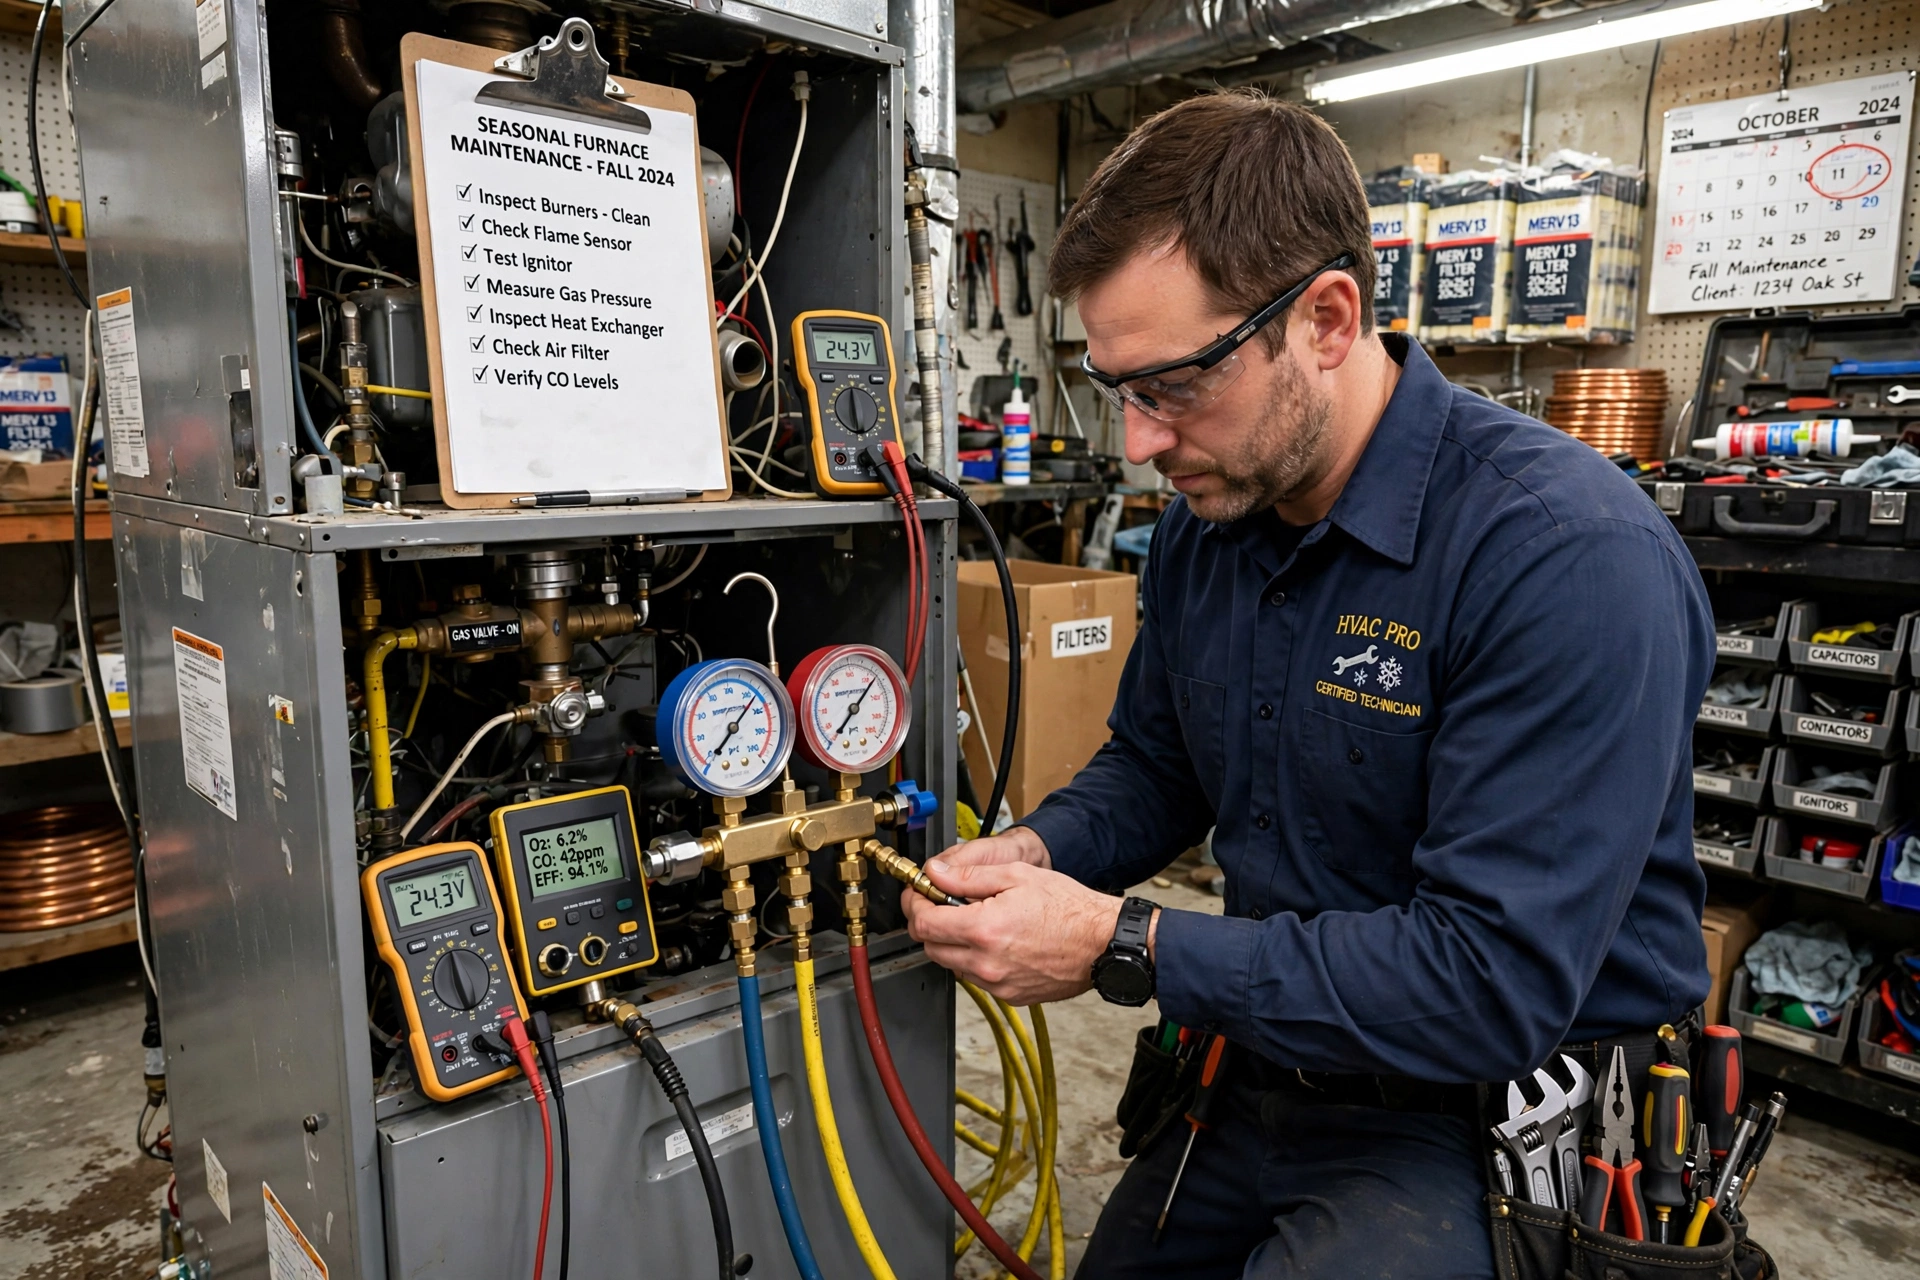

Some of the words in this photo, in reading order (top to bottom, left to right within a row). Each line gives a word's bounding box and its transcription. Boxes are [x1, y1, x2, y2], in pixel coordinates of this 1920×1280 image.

[1738, 107, 1820, 132] OCTOBER
[1858, 96, 1901, 115] 2024
[478, 116, 570, 147] SEASONAL
[574, 134, 650, 160] FURNACE
[1873, 130, 1882, 141] 6
[450, 135, 582, 171] MAINTENANCE
[597, 160, 634, 180] FALL
[638, 167, 675, 187] 2024
[1736, 179, 1744, 190] 9
[1832, 168, 1845, 180] 11
[1867, 163, 1882, 176] 12
[479, 188, 537, 211] Inspect
[541, 197, 598, 219] Burners
[612, 208, 651, 227] Clean
[1731, 208, 1744, 220] 15
[1763, 205, 1777, 217] 16
[1795, 202, 1809, 213] 17
[1370, 221, 1390, 236] ERV
[1438, 220, 1474, 236] MERV
[1475, 218, 1487, 232] 13
[1528, 215, 1566, 232] MERV
[1567, 213, 1580, 228] 13
[482, 219, 529, 239] Check
[534, 225, 580, 245] Flame
[583, 231, 632, 251] Sensor
[1696, 241, 1711, 253] 21
[1726, 238, 1742, 250] 22
[1757, 236, 1774, 248] 24
[1858, 227, 1876, 240] 29
[483, 248, 518, 267] Test
[523, 253, 573, 272] Ignitor
[1435, 248, 1468, 264] MERV
[1470, 246, 1483, 261] 13
[1525, 244, 1561, 261] MERV
[1563, 243, 1577, 258] 13
[1439, 262, 1476, 277] FILTER
[1529, 258, 1569, 274] FILTER
[1688, 262, 1719, 280] Fall
[1727, 255, 1828, 277] Maintenance
[486, 278, 555, 300] Measure
[560, 286, 587, 303] Gas
[591, 288, 652, 309] Pressure
[1691, 283, 1744, 301] Client:
[1753, 277, 1793, 297] 1234
[1801, 274, 1835, 291] Oak
[1843, 271, 1865, 288] St
[490, 308, 547, 329] Inspect
[551, 314, 587, 331] Heat
[591, 316, 664, 339] Exchanger
[492, 338, 541, 357] Check
[545, 342, 567, 358] Air
[571, 343, 610, 360] Filter
[826, 340, 871, 360] 24.3V
[494, 368, 542, 389] Verify
[547, 371, 569, 387] CO
[573, 372, 619, 390] Levels
[1, 414, 39, 427] MERV
[7, 426, 52, 440] FILTER
[452, 629, 471, 641] GAS
[472, 625, 499, 639] VALVE
[506, 623, 519, 635] ON
[1057, 624, 1107, 650] FILTERS
[1336, 615, 1382, 637] HVAC
[1384, 621, 1421, 650] PRO
[1811, 649, 1877, 666] CAPACITORS
[1316, 680, 1358, 703] CERTIFIED
[1360, 693, 1421, 717] TECHNICIAN
[1800, 719, 1869, 740] CONTACTORS
[1799, 795, 1849, 813] IGNITORS
[529, 837, 551, 852] O2:
[556, 828, 588, 847] 6.2%
[532, 853, 557, 869] CO:
[560, 846, 604, 864] 42ppm
[535, 869, 564, 888] EFF:
[567, 859, 609, 880] 94.1%
[409, 878, 465, 917] 24.3V
